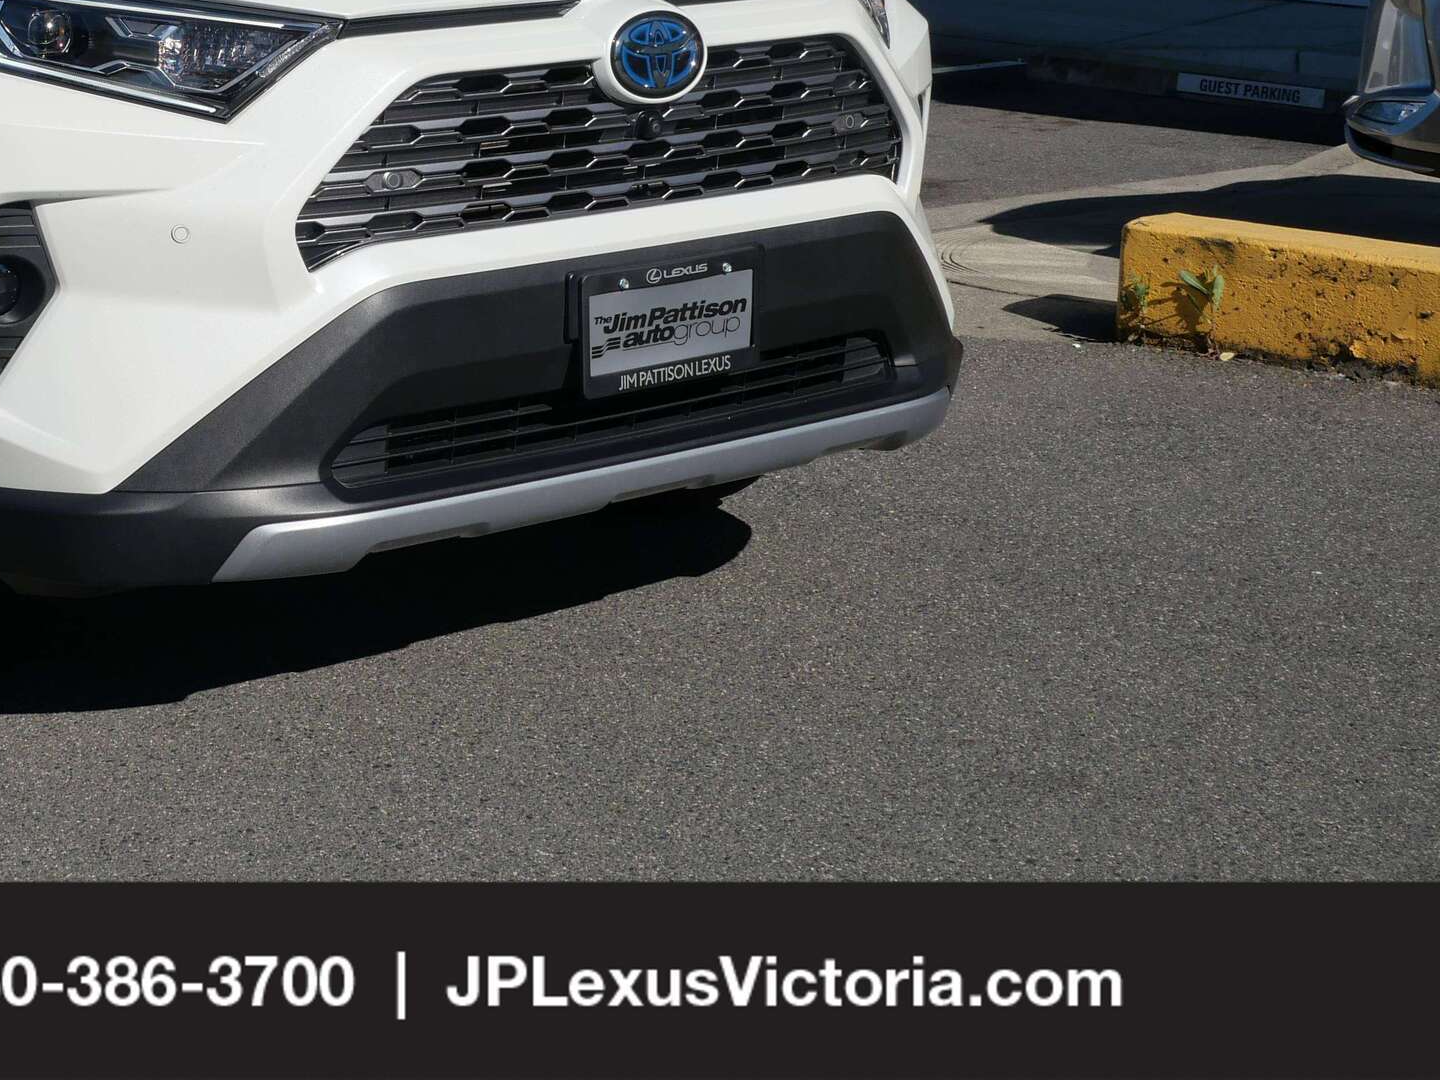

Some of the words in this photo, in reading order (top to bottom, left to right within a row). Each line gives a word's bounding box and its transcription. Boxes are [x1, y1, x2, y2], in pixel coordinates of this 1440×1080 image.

[1199, 78, 1241, 96] GUEST
[1243, 84, 1301, 103] PARKING
[663, 263, 708, 279] LEXUS
[594, 316, 611, 326] The
[618, 374, 638, 391] JIM
[639, 362, 694, 387] PATTISON
[695, 355, 731, 376] LEXUS
